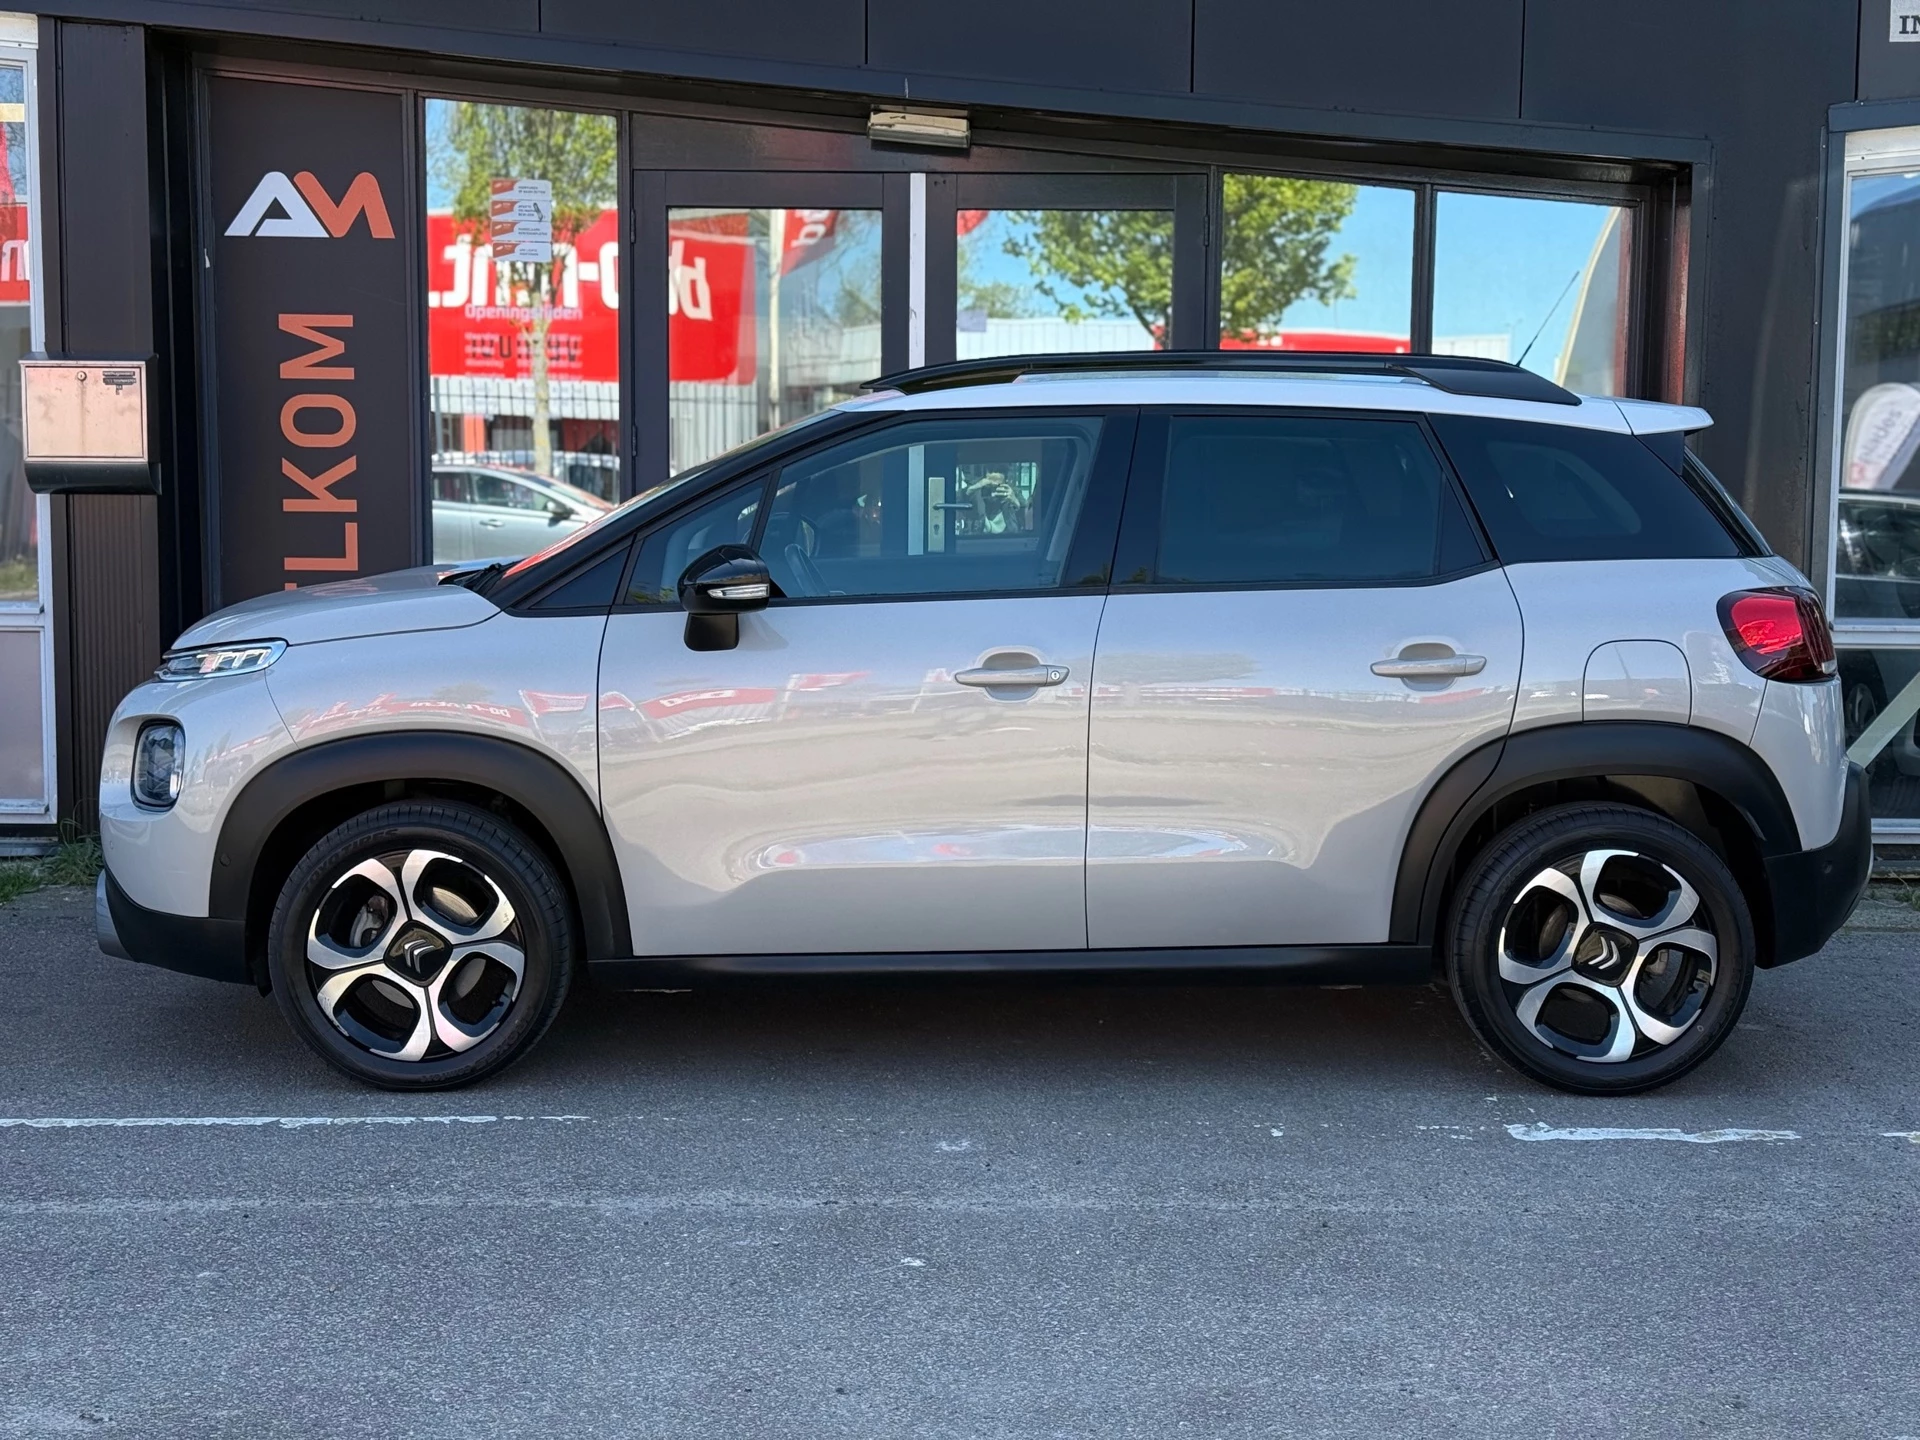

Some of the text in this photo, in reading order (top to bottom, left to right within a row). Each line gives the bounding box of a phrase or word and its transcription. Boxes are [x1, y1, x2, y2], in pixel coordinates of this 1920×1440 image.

[224, 171, 395, 239] AM
[279, 314, 358, 591] LKOM
[338, 828, 399, 859] TIRES
